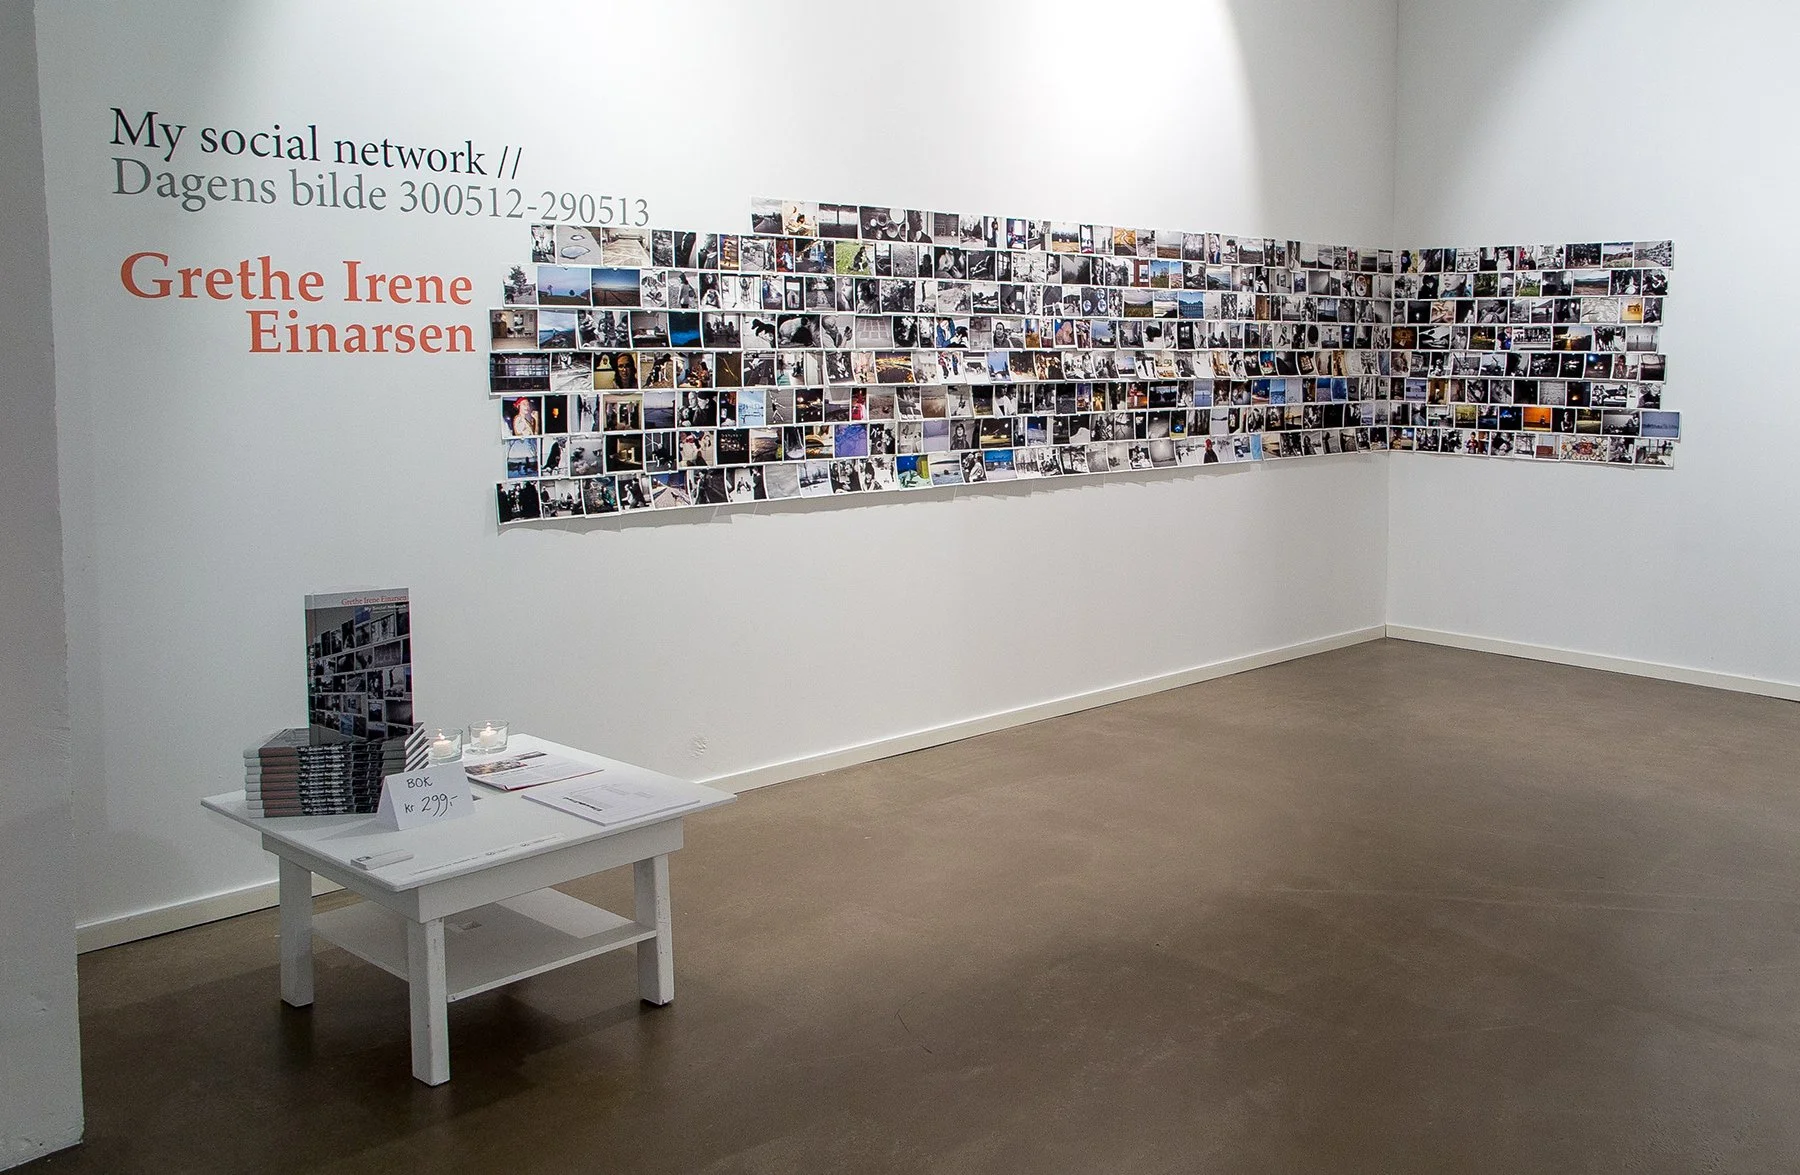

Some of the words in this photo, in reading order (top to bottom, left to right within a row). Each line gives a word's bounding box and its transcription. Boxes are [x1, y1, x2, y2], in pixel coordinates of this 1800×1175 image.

[109, 108, 187, 163] My
[200, 124, 321, 163] social
[332, 138, 488, 176] network
[496, 145, 523, 180] //
[111, 157, 277, 212] Dagens
[288, 168, 387, 212] bilde
[399, 181, 650, 227] 300512-290513
[120, 252, 325, 303] Grethe
[342, 260, 473, 305] Irene
[245, 309, 477, 354] Einarsen
[341, 597, 363, 606] Grethe
[364, 596, 380, 604] Irene
[381, 595, 408, 603] Einarsen
[406, 776, 433, 789] BOK
